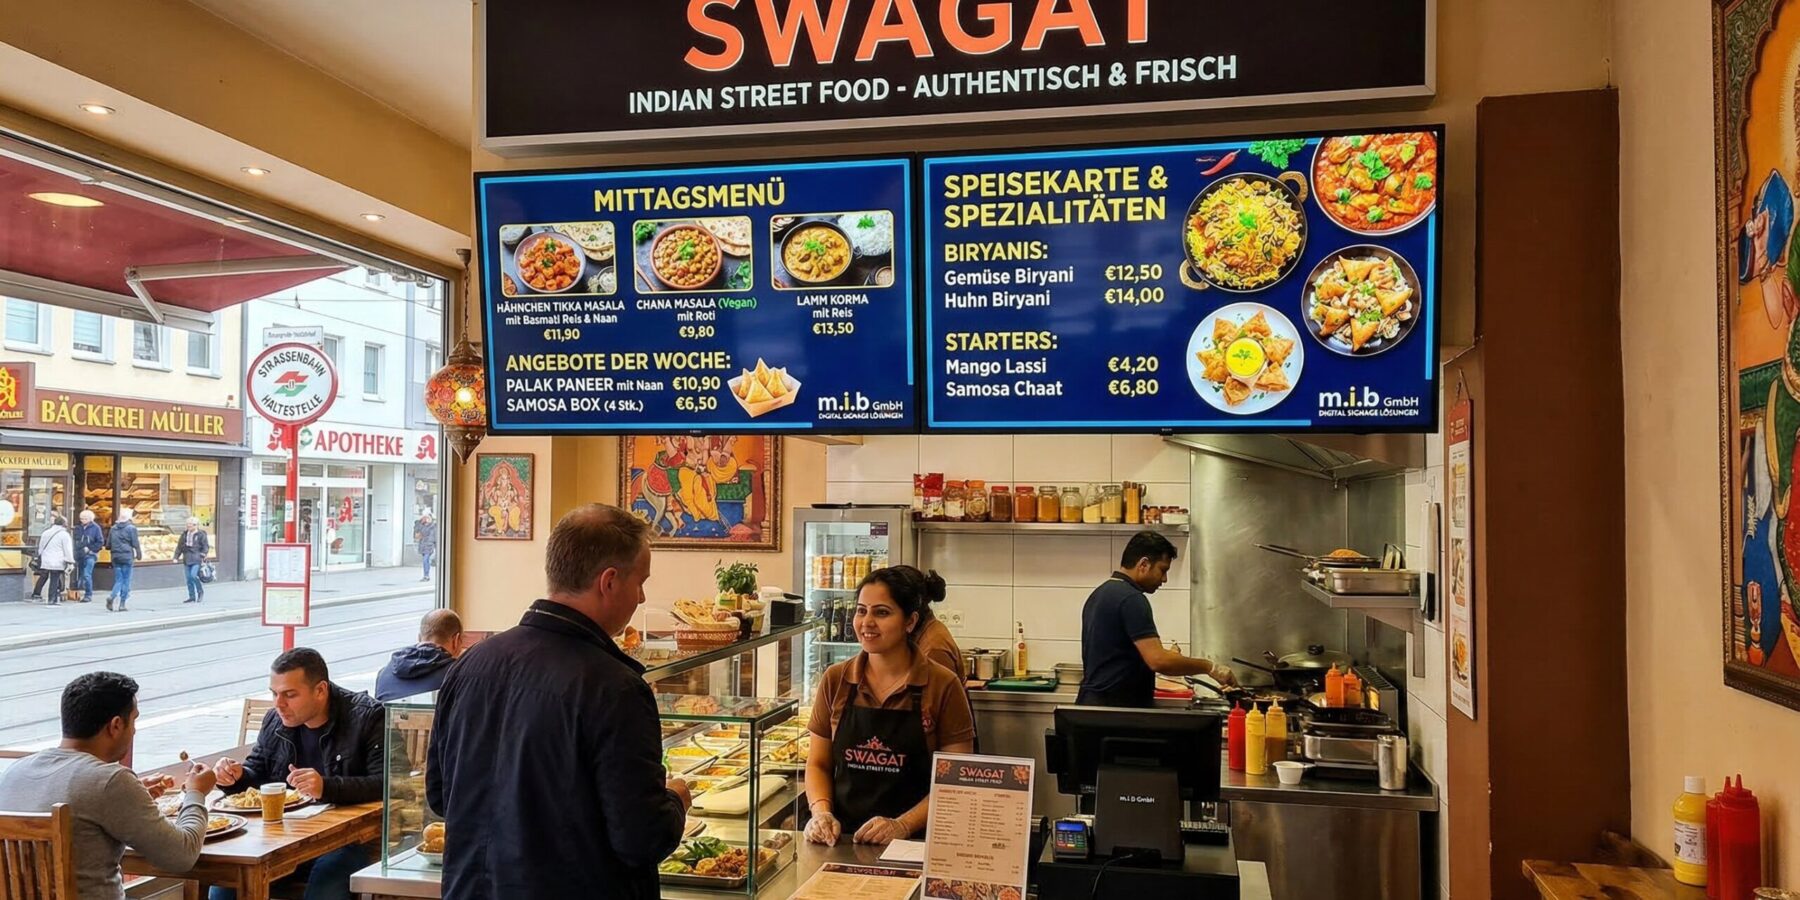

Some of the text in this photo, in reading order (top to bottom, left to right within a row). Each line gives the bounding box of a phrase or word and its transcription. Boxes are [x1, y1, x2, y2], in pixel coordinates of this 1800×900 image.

[629, 88, 712, 114] INDIAN
[720, 82, 812, 109] STREET
[819, 78, 890, 104] FOOD
[913, 64, 1100, 98] AUTHENTISCH
[1108, 62, 1127, 87] &
[1135, 55, 1237, 85] FRISCH
[944, 165, 1168, 198] SPEISEKARTE &
[594, 176, 785, 212] MITTAGSMENÜ
[944, 194, 1166, 228] SPEZIALITÄTEN
[944, 240, 1048, 262] BIRYANIS:
[944, 264, 1162, 286] Gemüse Biryani €12,50
[496, 300, 625, 313] HÄHNCHEN TIKKA MASALA
[636, 297, 757, 310] CHANA MASALA (Vegan)
[797, 294, 869, 306] LAMM KORMA
[945, 287, 1164, 310] Huhn Biryani €14,00
[505, 313, 618, 325] mit Basmati Reis & Naan
[677, 310, 715, 321] mit Roti
[812, 307, 853, 318] mit Reis
[543, 328, 580, 342] €11,90
[679, 325, 715, 339] €9,80
[812, 322, 854, 336] €13,50
[945, 331, 1058, 351] STARTERS:
[258, 351, 326, 378] STRASSENBAHN
[505, 352, 731, 372] ANGEBOTE DER WOCHE:
[946, 356, 1159, 377] Mango Lassi €4,20
[506, 376, 721, 392] PALAK PANEER mit Naan €10,90
[946, 379, 1159, 398] Samosa Chaat €6,80
[261, 394, 323, 416] HALTESTELLE
[506, 396, 717, 413] SAMOSA BOX (4 Stk.) €6,50
[818, 391, 903, 411] m.i.b GmbH
[1319, 386, 1419, 407] m.i.b GmbH
[41, 395, 224, 435] BÄCKEREI MÜLLER
[1318, 408, 1419, 417] DIGITAL SIGNAGE LÖSUNGEN
[314, 430, 403, 456] APOTHEKE
[845, 748, 907, 766] SWAGAT
[959, 766, 1005, 779] SWAGAT
